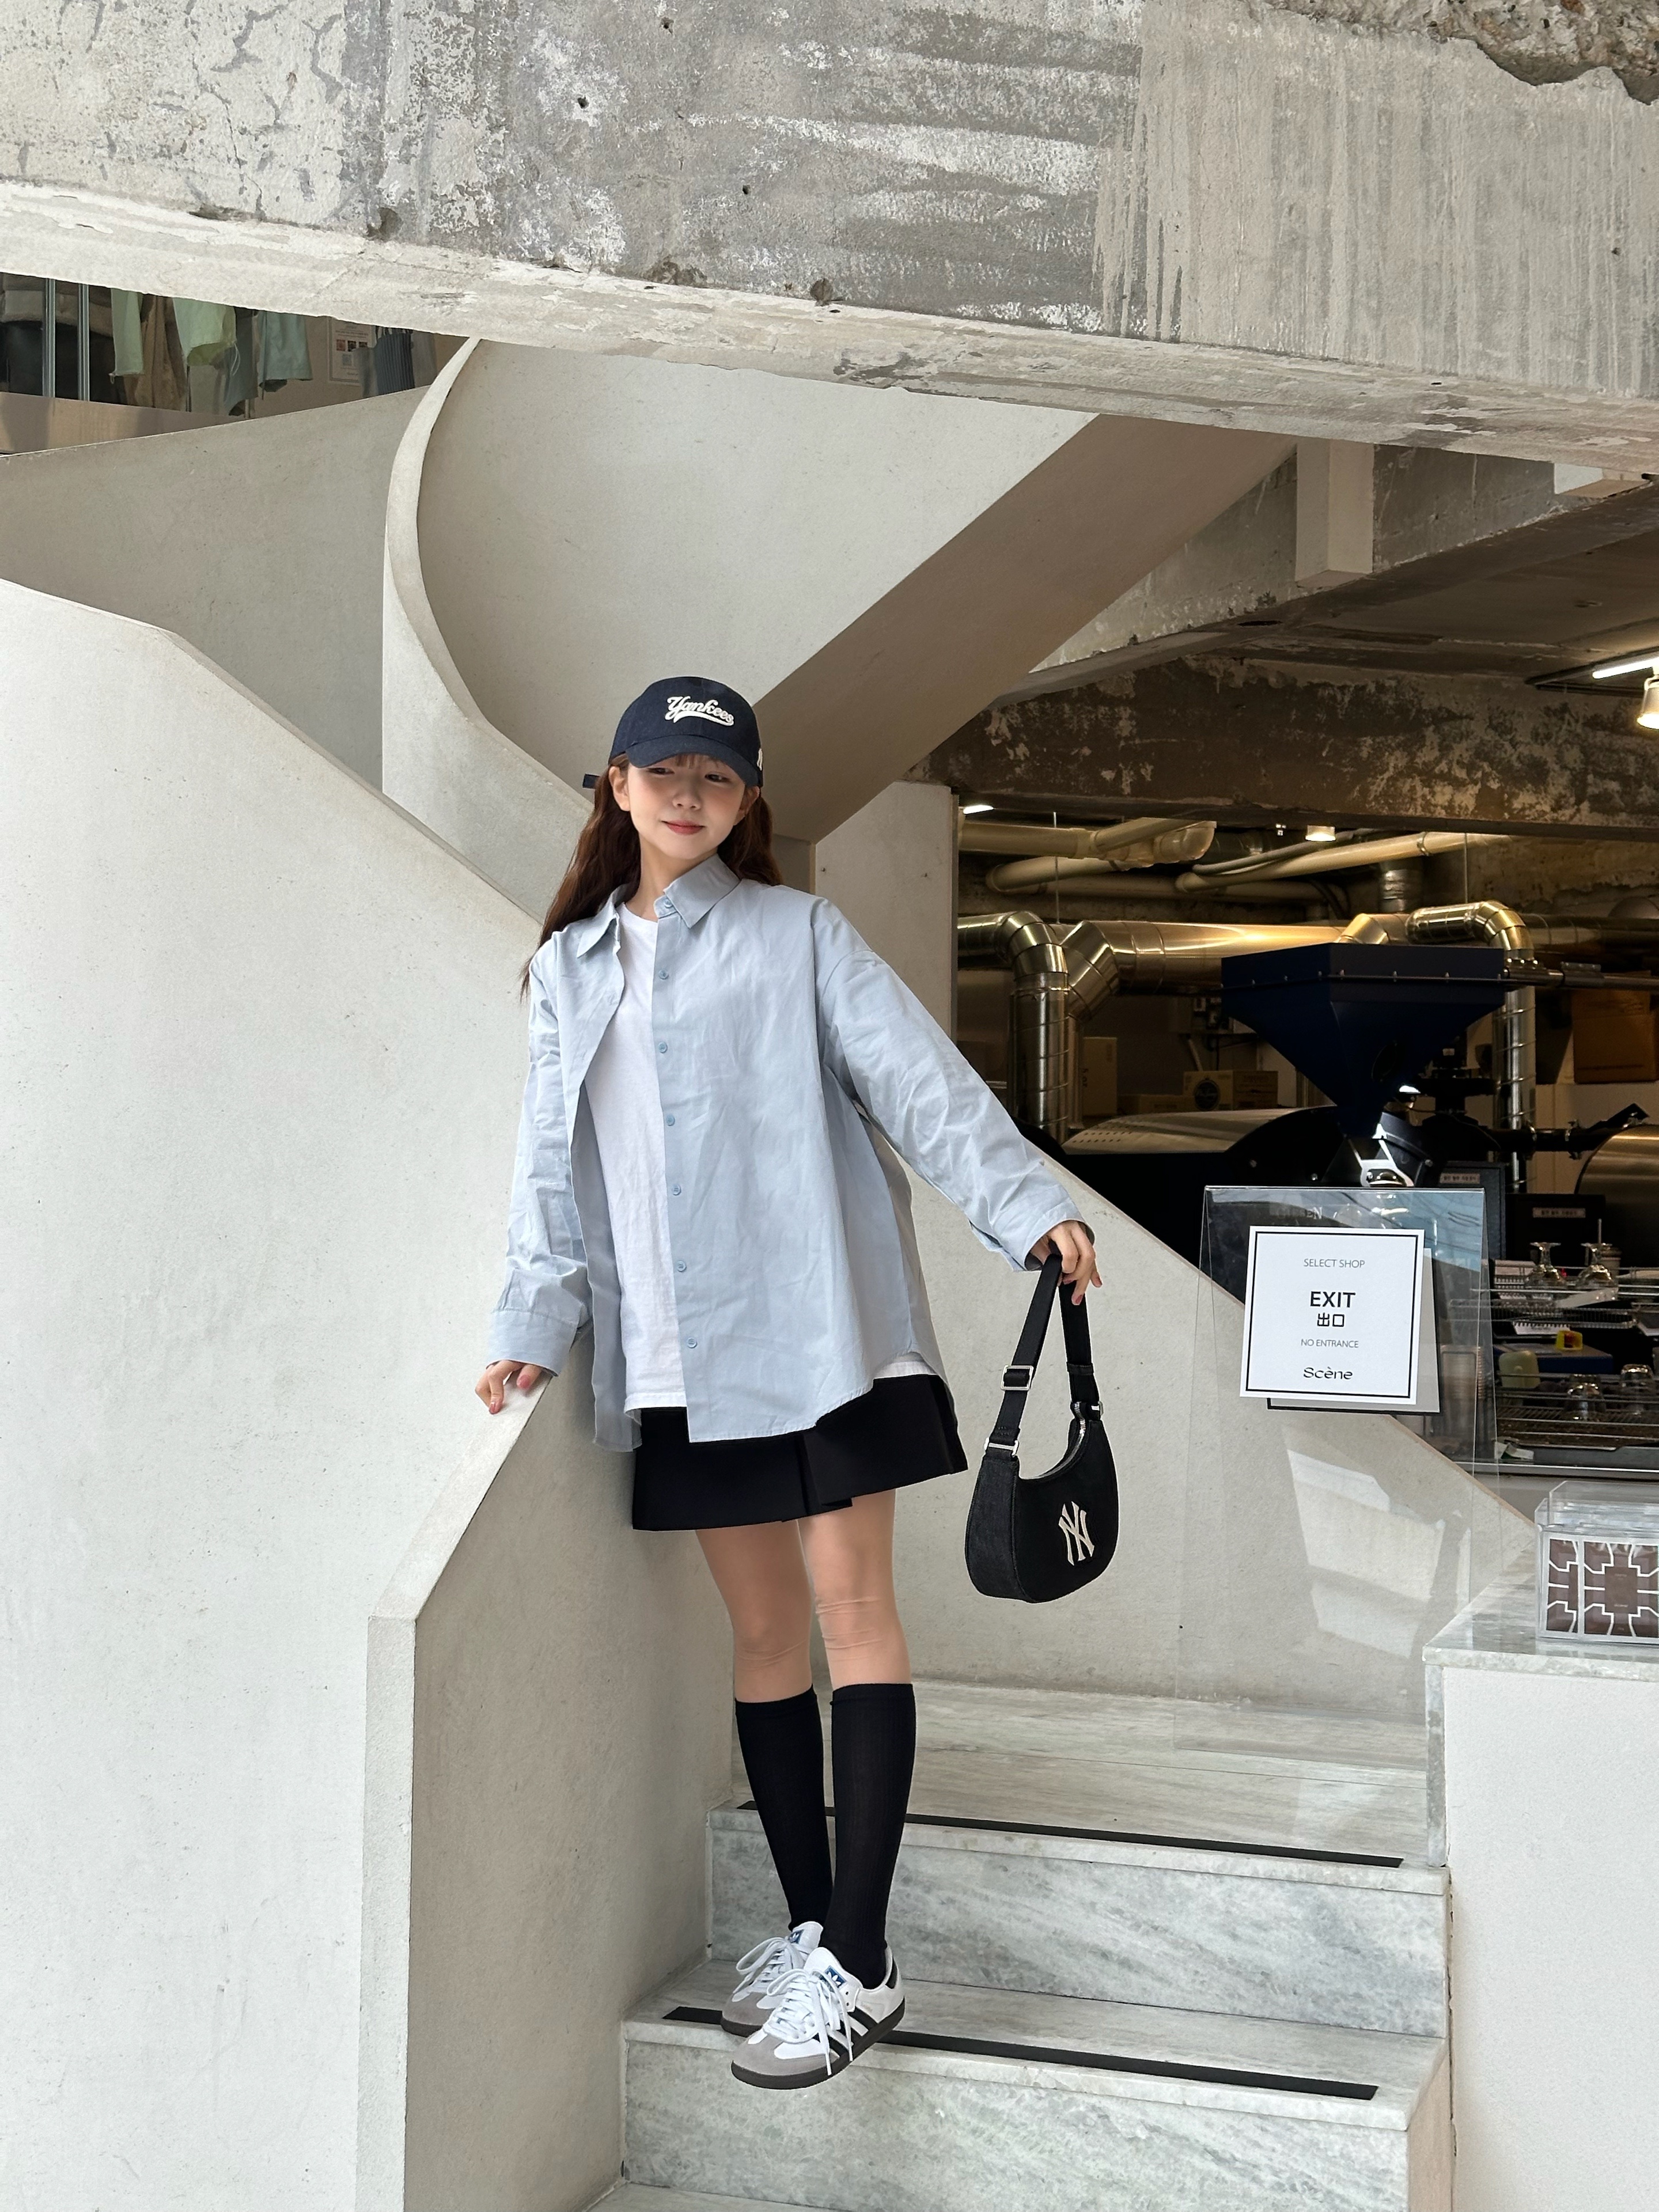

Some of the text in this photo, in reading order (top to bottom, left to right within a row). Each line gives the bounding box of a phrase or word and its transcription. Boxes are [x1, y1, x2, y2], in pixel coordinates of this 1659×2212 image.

[665, 695, 734, 726] Yankees
[1304, 1259, 1365, 1268] SELECT SHOP
[1310, 1291, 1356, 1308] EXIT
[1317, 1312, 1344, 1327] 出口
[1316, 1339, 1359, 1348] ENTRANCE
[1304, 1366, 1353, 1380] Scène
[1058, 1501, 1094, 1566] NY
